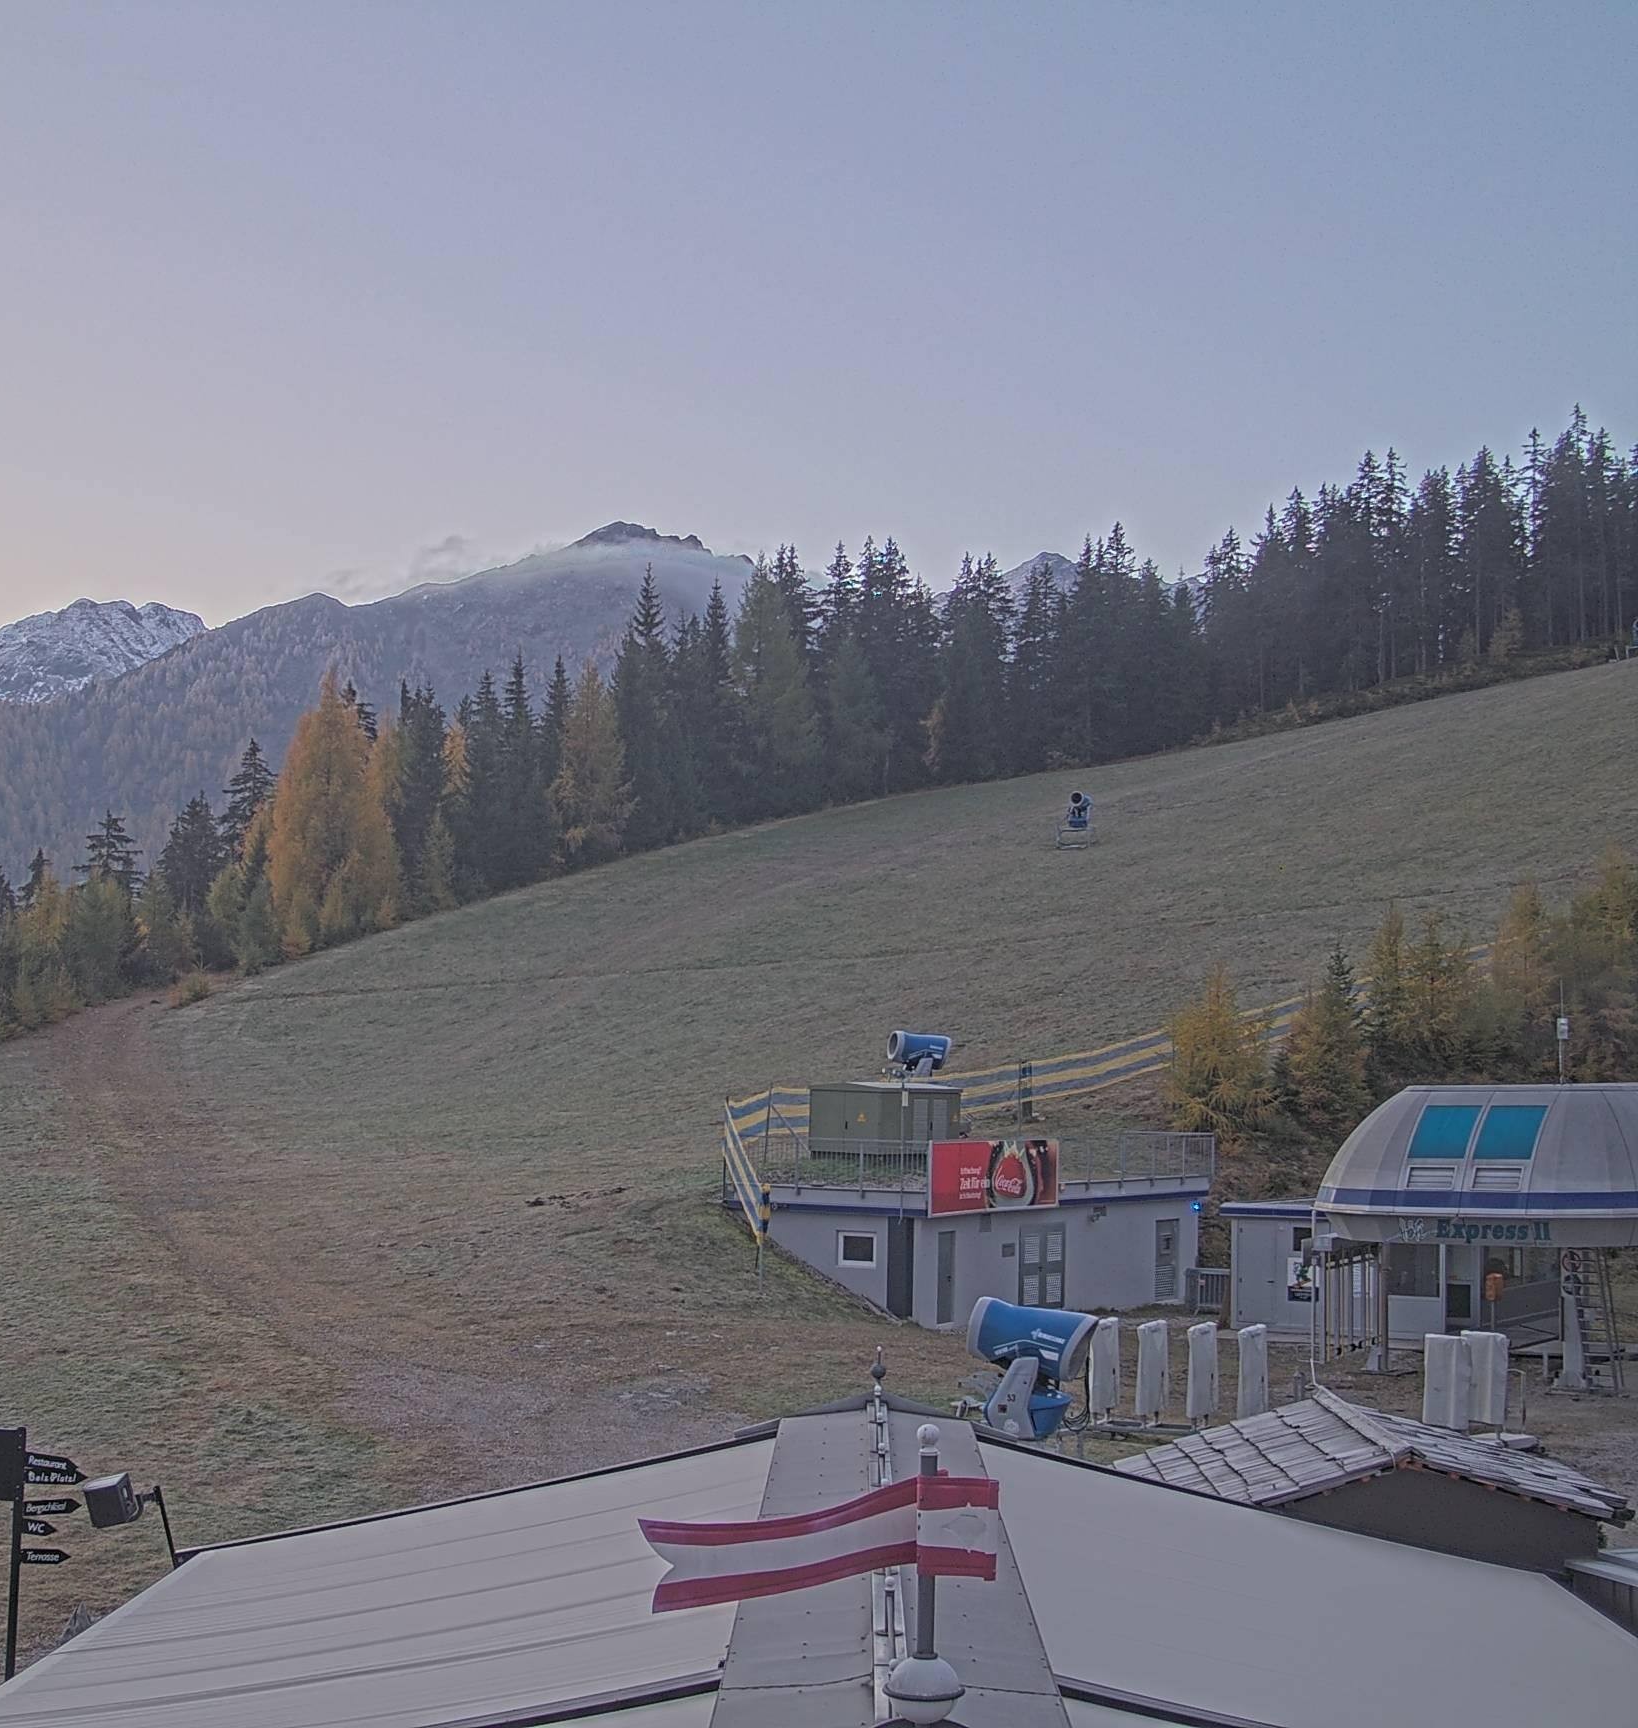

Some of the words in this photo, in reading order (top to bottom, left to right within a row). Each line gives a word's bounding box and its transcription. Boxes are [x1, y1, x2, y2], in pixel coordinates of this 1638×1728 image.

[1435, 1218, 1529, 1244] Express
[1006, 1393, 1016, 1402] 53
[28, 1455, 67, 1470] Restaurant
[27, 1522, 46, 1533] WC
[26, 1551, 60, 1562] Terrasse
